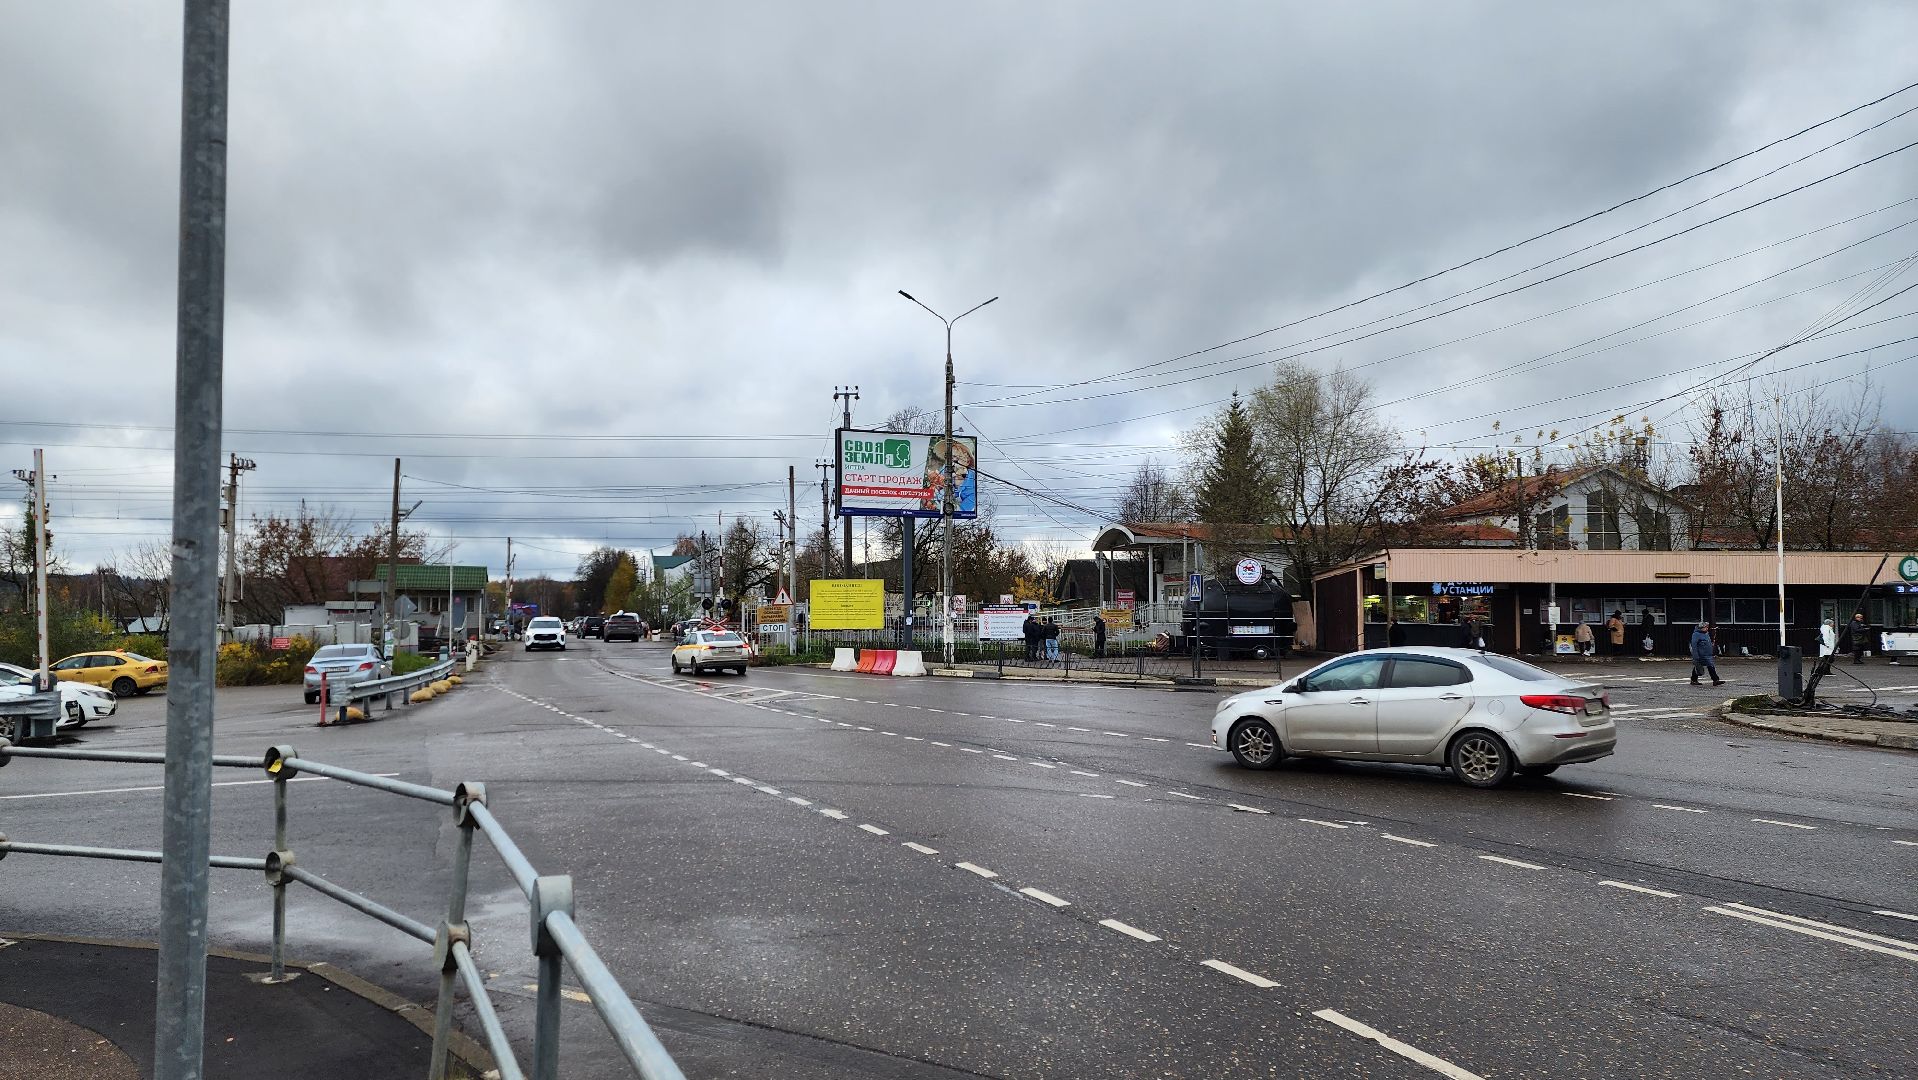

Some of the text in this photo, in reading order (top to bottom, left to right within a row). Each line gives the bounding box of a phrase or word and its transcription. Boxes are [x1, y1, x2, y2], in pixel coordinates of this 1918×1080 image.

[844, 440, 883, 453] СВОЯ
[844, 452, 894, 466] ЗЕМЛЯ
[844, 473, 922, 485] СТАРТ ПРОДАЖ
[1442, 586, 1494, 595] У СТАНЦИИ
[762, 624, 784, 632] СТОП
